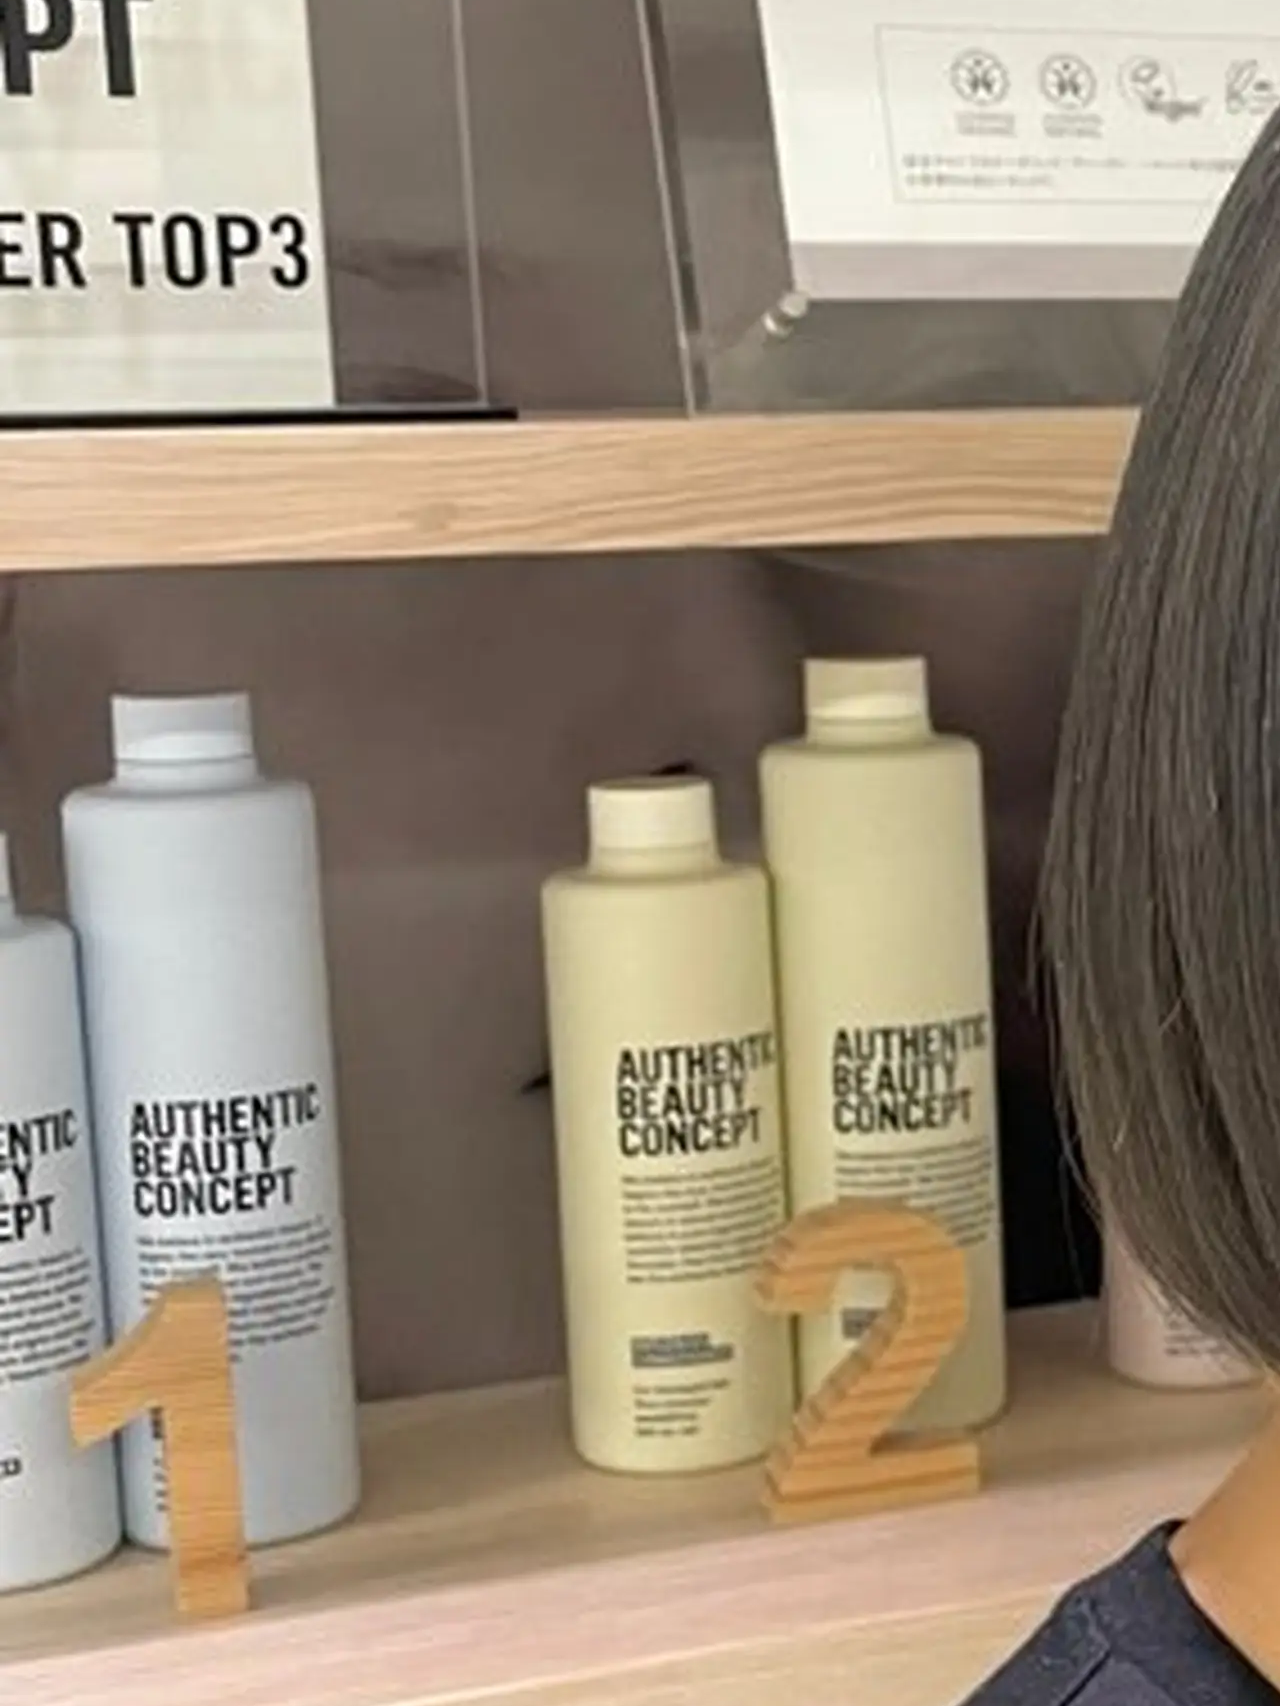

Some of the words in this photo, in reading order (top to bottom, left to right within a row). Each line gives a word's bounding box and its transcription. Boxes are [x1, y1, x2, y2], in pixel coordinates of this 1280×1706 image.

[112, 212, 309, 289] TOP3
[616, 1078, 745, 1122] BEAUTY
[832, 1059, 957, 1098] BEAUTY
[130, 1082, 320, 1139] AUTHENTIC
[618, 1107, 762, 1157] CONCEPT
[832, 1088, 974, 1134] CONCEPT
[131, 1133, 275, 1179] BEAUTY
[133, 1166, 296, 1218] CONCEPT
